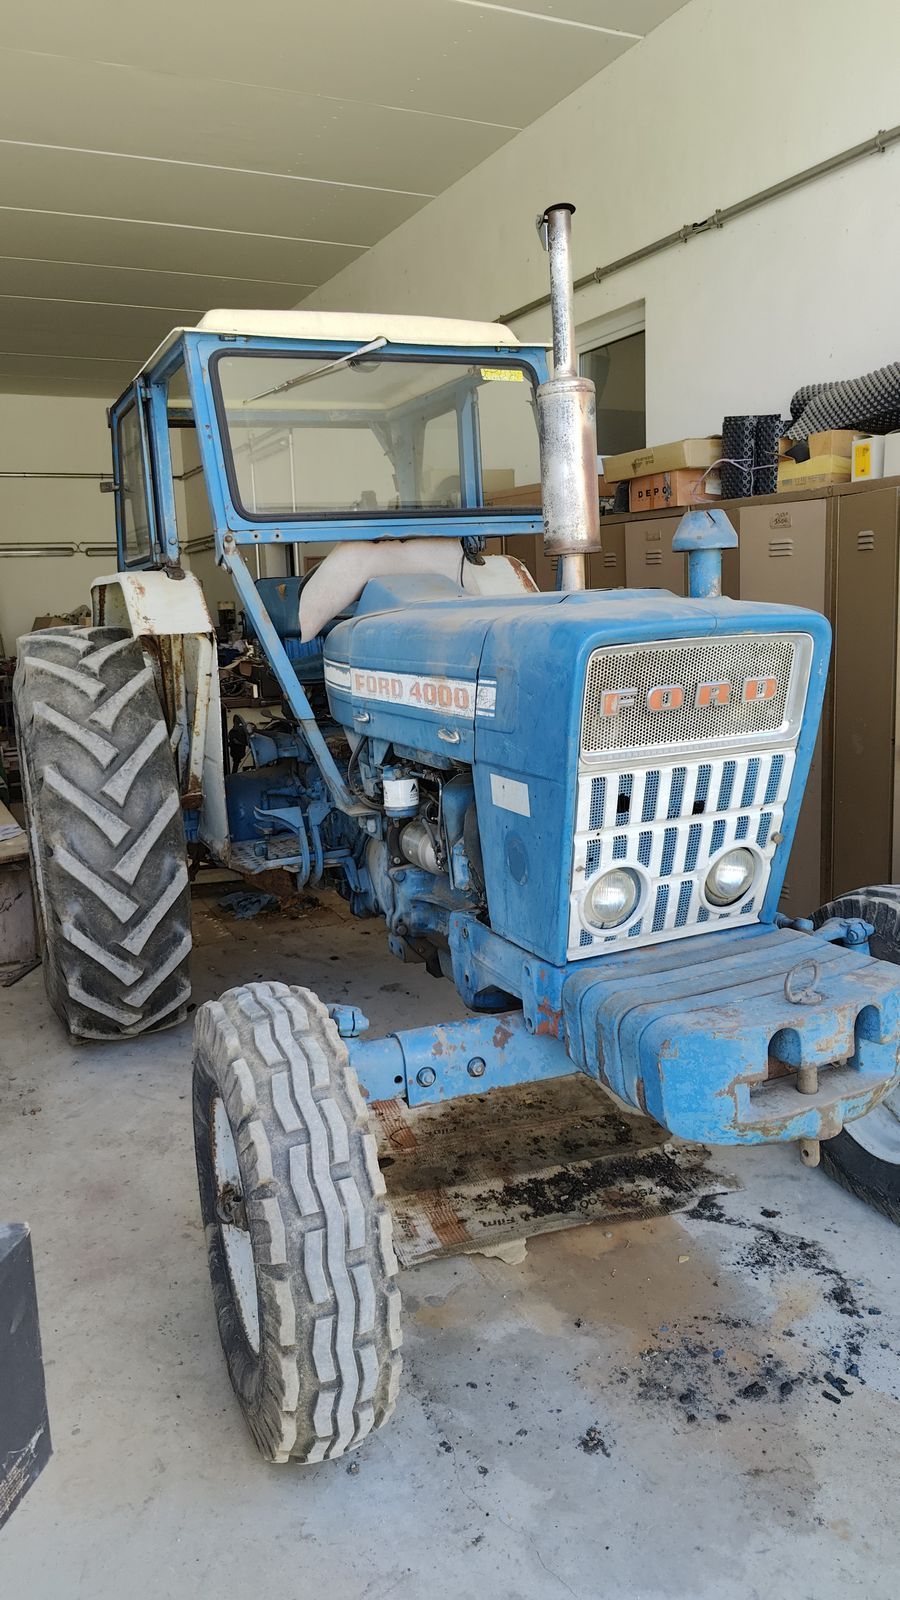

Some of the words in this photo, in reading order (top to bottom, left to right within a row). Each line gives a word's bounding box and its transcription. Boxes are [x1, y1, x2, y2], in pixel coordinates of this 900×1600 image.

[354, 673, 404, 698] FORD
[409, 681, 470, 710] 4000
[601, 674, 778, 718] FORD
